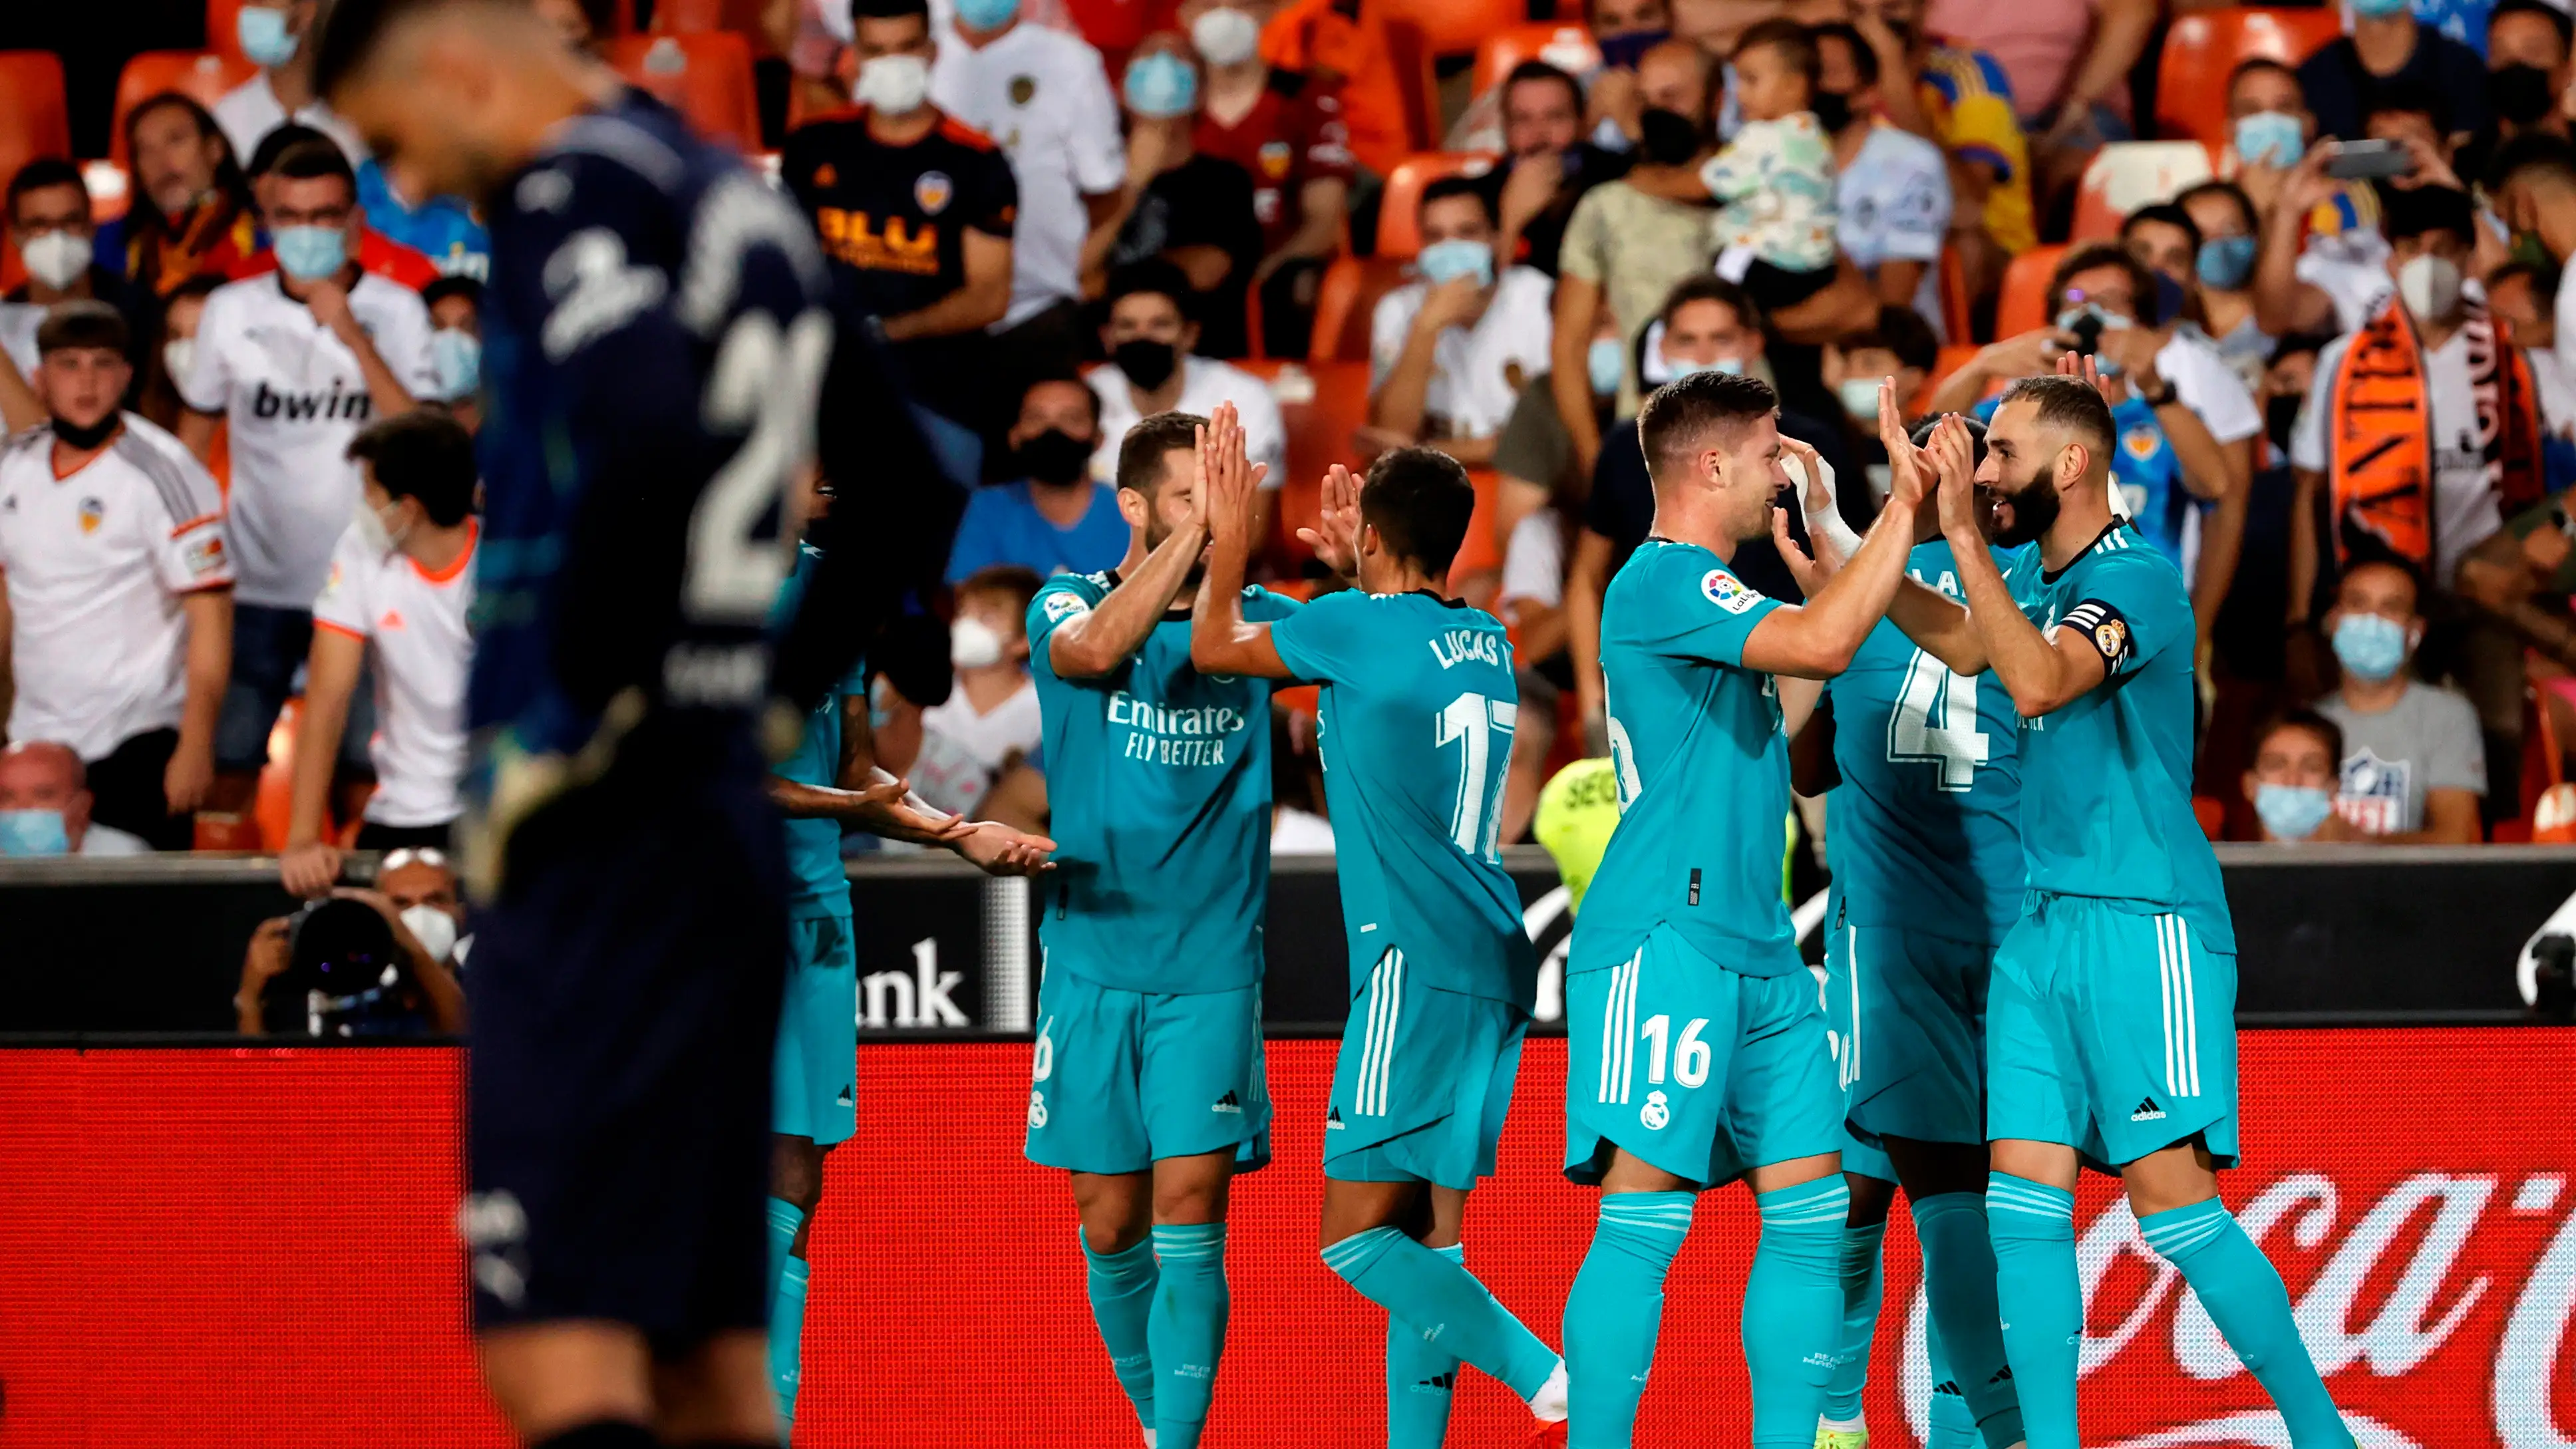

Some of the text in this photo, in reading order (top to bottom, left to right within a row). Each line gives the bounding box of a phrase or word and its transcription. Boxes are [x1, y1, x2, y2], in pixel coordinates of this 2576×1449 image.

[254, 379, 371, 420] bwin
[1428, 629, 1498, 670] LUCAS
[1107, 690, 1245, 735] Emirates
[1887, 647, 1989, 792] 4
[1124, 732, 1225, 766] FLY BETTER
[1435, 692, 1518, 865] 17
[855, 937, 971, 1029] nk
[1033, 1015, 1054, 1082] 6
[1641, 1014, 1711, 1088] 16
[2131, 1110, 2167, 1122] adidas
